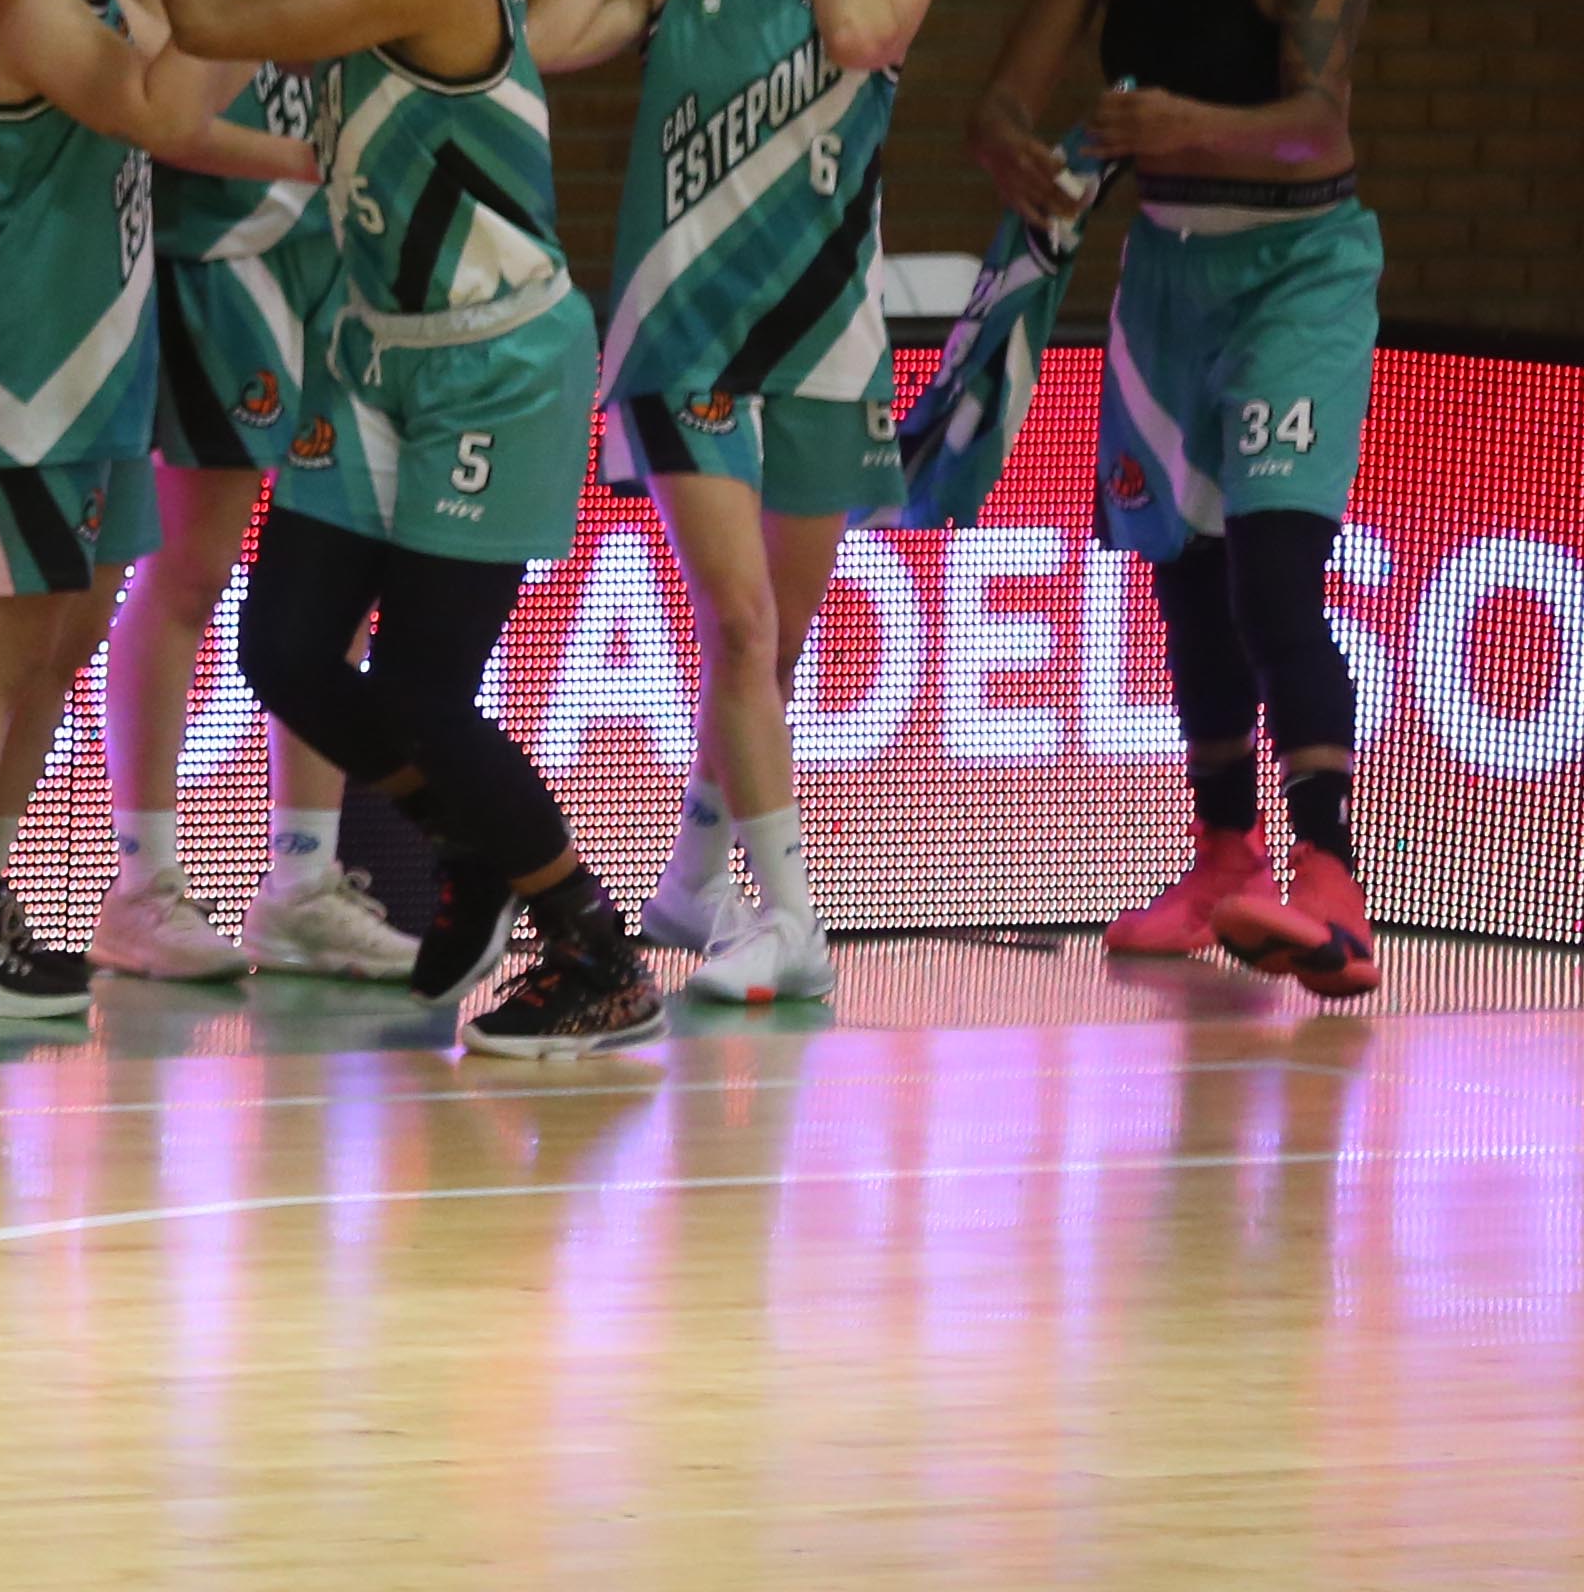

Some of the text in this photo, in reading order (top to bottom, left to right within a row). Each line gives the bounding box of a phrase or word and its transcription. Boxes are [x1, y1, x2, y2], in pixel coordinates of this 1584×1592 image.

[662, 93, 698, 154] CAB
[810, 132, 842, 196] 6
[1238, 397, 1316, 456] 34
[450, 430, 496, 494] 5
[788, 527, 1187, 765] DEL
